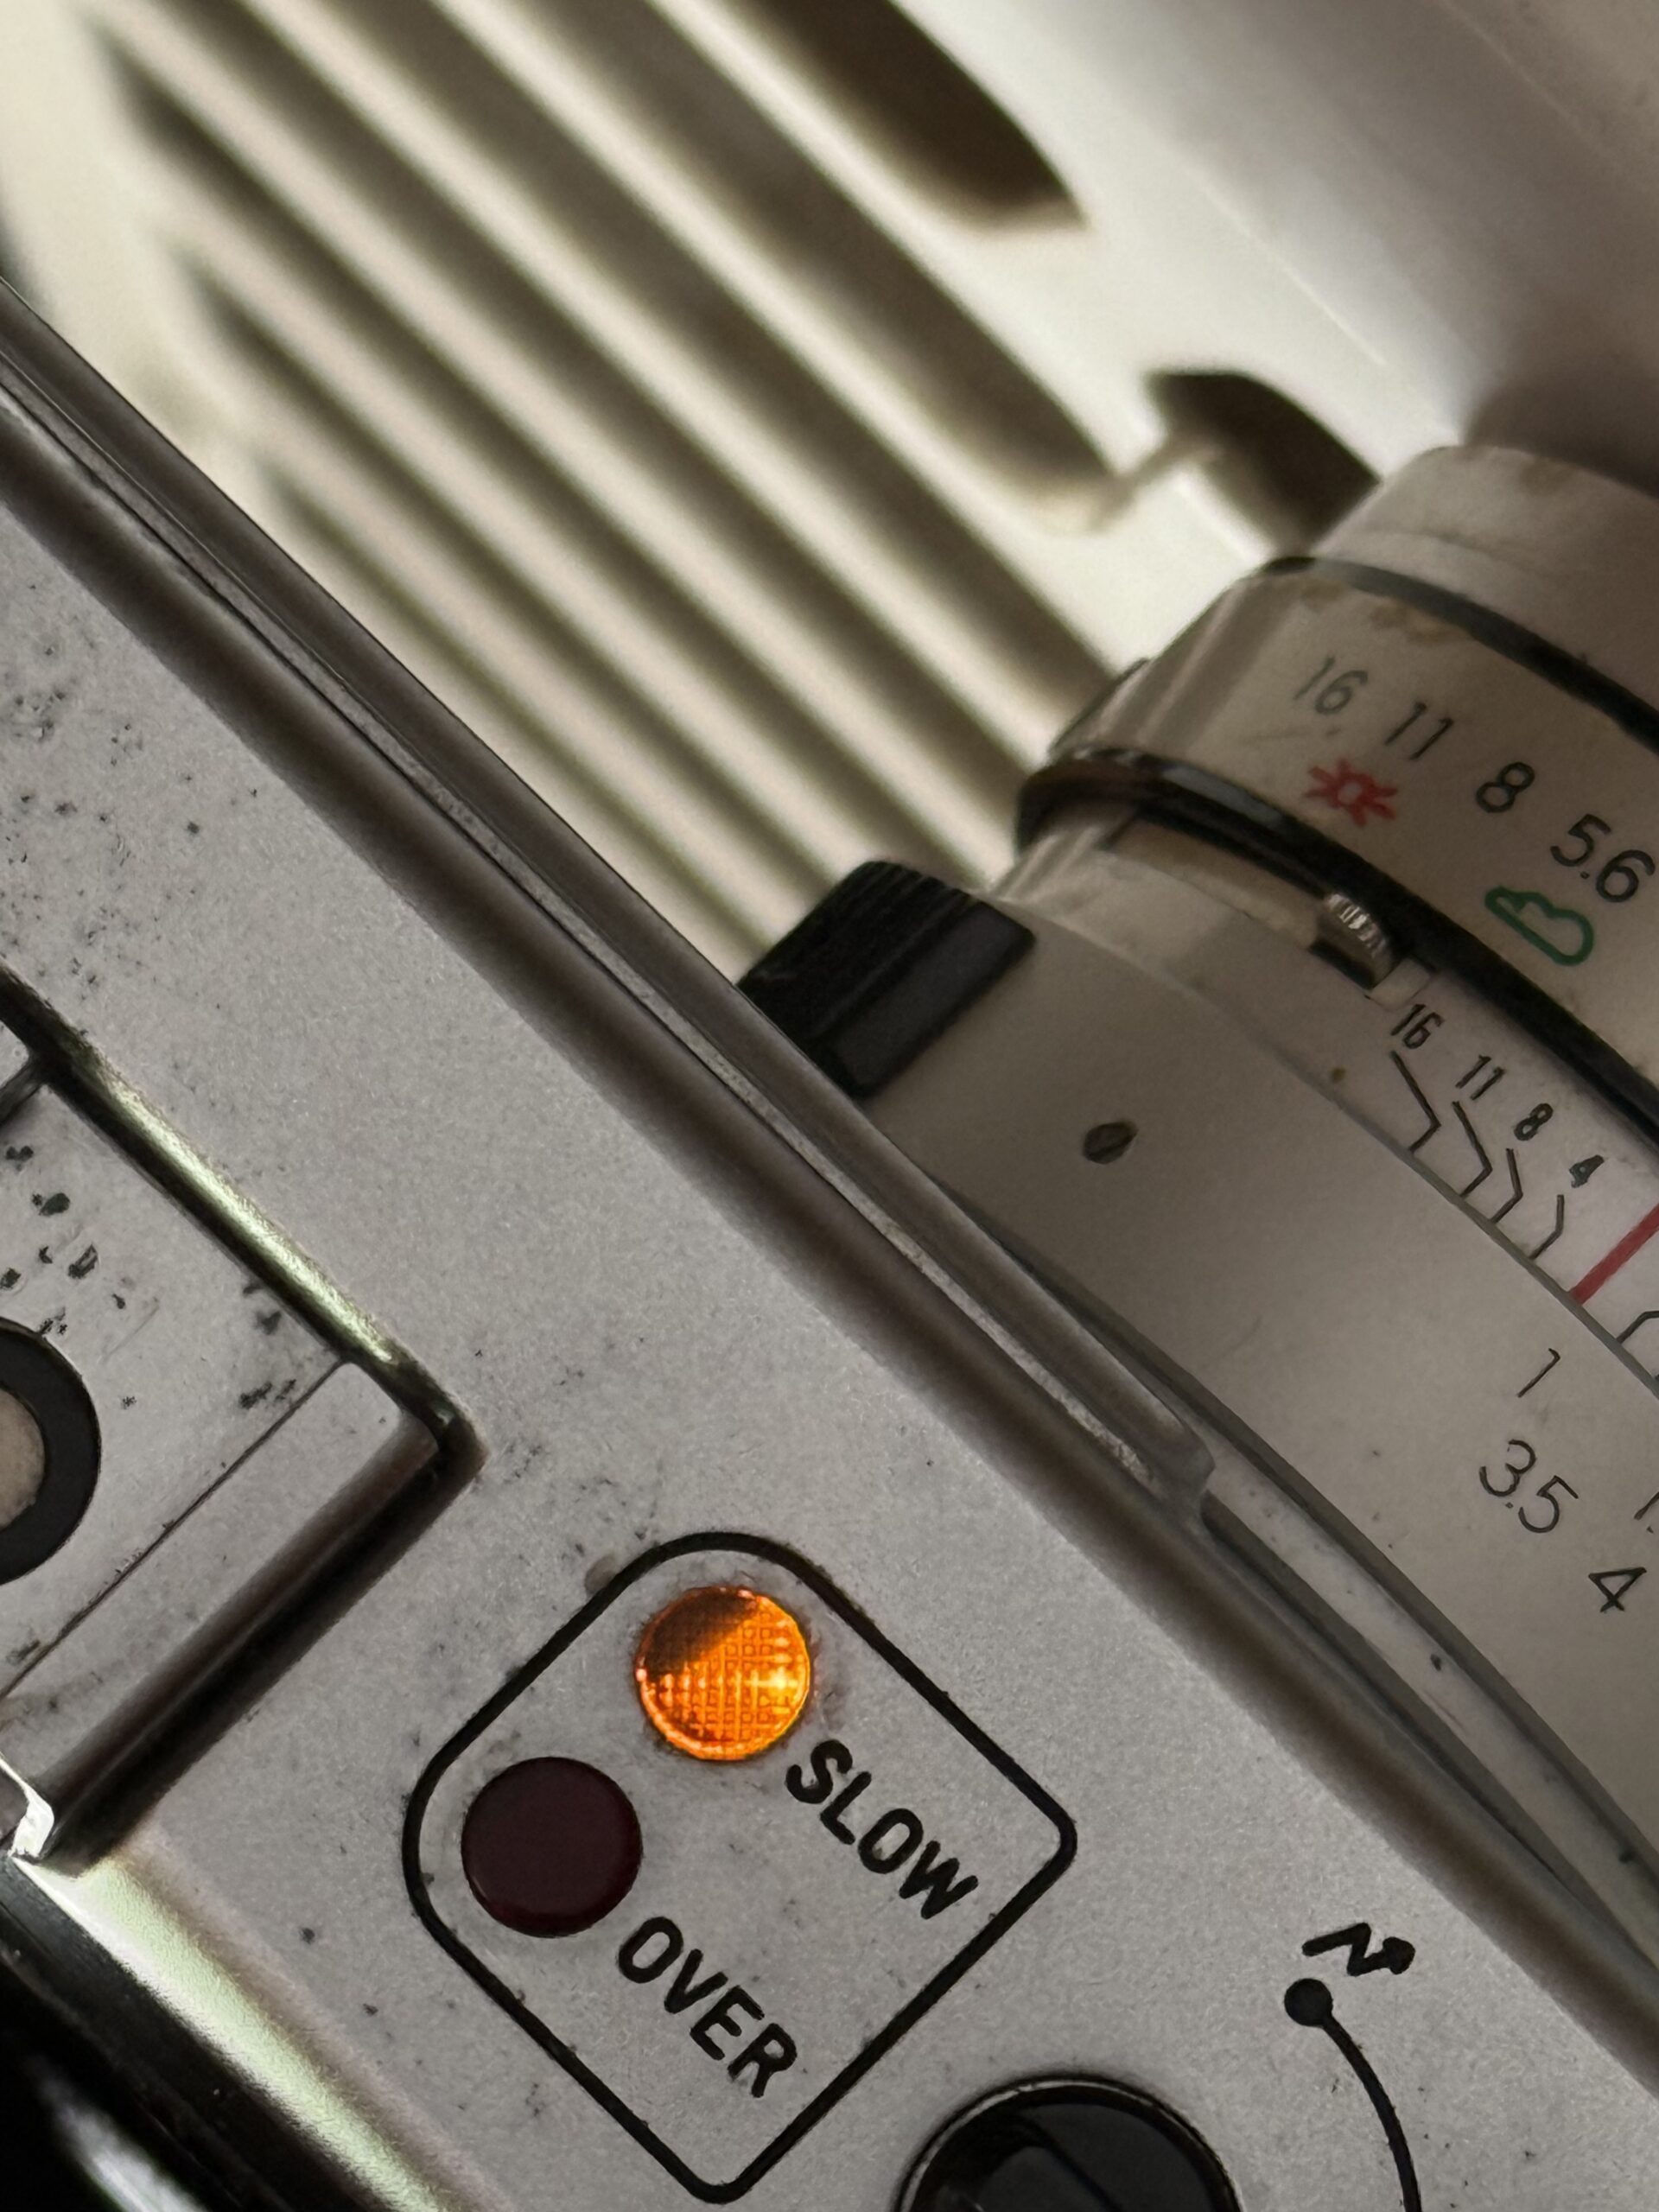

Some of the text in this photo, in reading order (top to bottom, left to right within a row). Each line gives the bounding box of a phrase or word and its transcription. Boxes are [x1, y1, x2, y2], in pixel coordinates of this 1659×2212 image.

[1293, 653, 1656, 904] 16 11 8 5.6
[1390, 1003, 1446, 1050] 16
[1454, 1054, 1507, 1102] 11
[1513, 1102, 1554, 1142] 8
[1478, 1438, 1648, 1613] 3.5 4
[785, 1738, 980, 1920] SLOW
[617, 1915, 798, 2099] OVER
